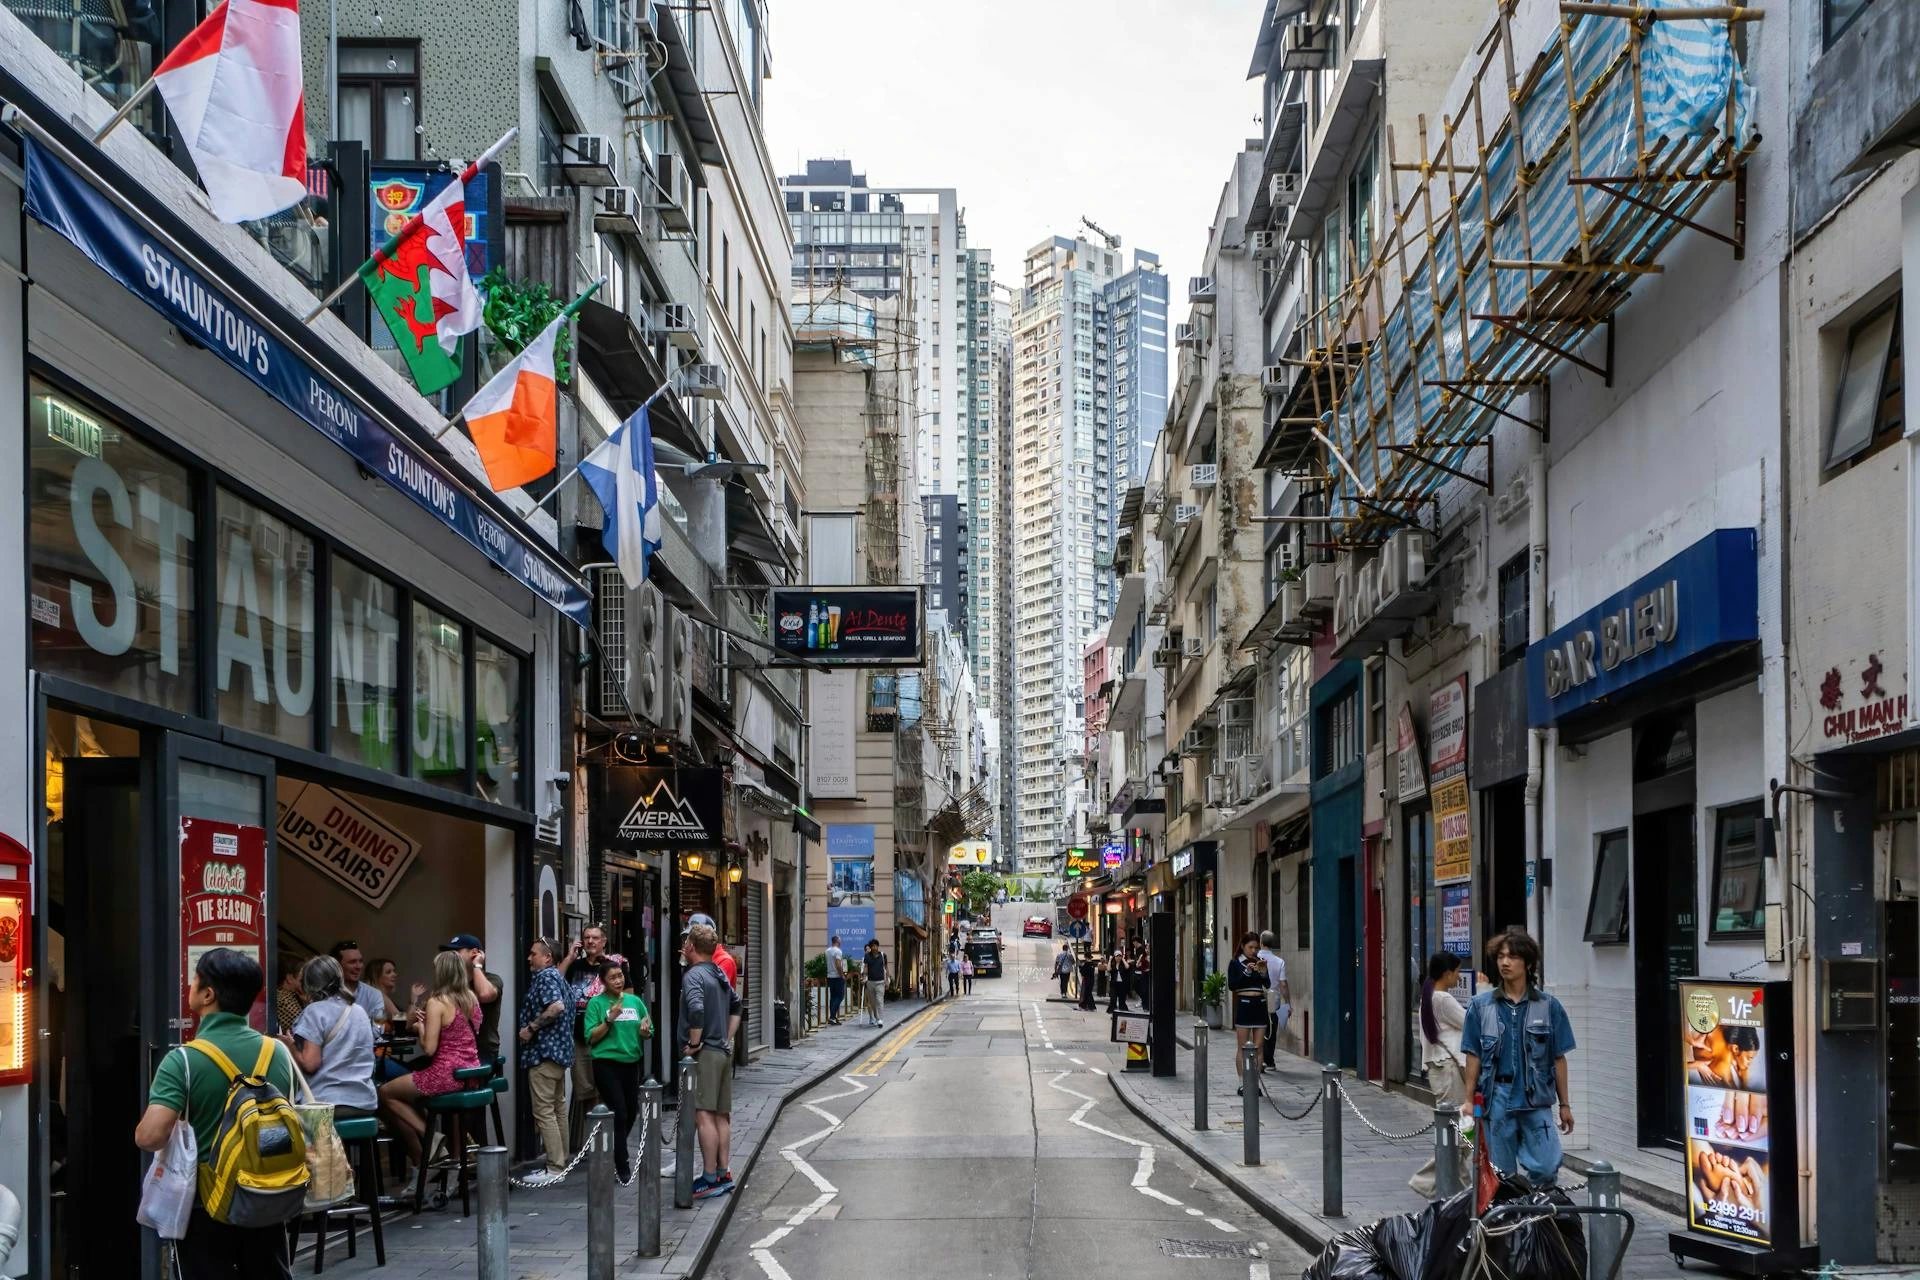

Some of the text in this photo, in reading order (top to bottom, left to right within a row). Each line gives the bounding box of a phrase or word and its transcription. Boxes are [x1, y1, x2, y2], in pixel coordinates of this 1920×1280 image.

[142, 244, 269, 375] STAUNTON'S
[310, 376, 358, 438] PERONI
[388, 442, 456, 521] STAUNTON'S
[477, 513, 506, 555] PERONI
[866, 609, 907, 628] Dente
[1544, 580, 1678, 699] BAR BLEU
[1824, 709, 1855, 738] CHUI
[1859, 697, 1894, 729] MAN
[1882, 719, 1903, 735] Street
[616, 828, 709, 841] Nepalese Cuisine
[629, 811, 694, 826] NEPAL
[283, 811, 385, 889] UPSTAIRS
[323, 806, 399, 867] DINING
[196, 898, 253, 925] THE SEASON
[1727, 995, 1753, 1020] 1/F
[1704, 1217, 1729, 1230] 11:30am
[1733, 1224, 1759, 1237] 12:30am
[1709, 1199, 1738, 1218] 2499
[1738, 1206, 1766, 1224] 2911
